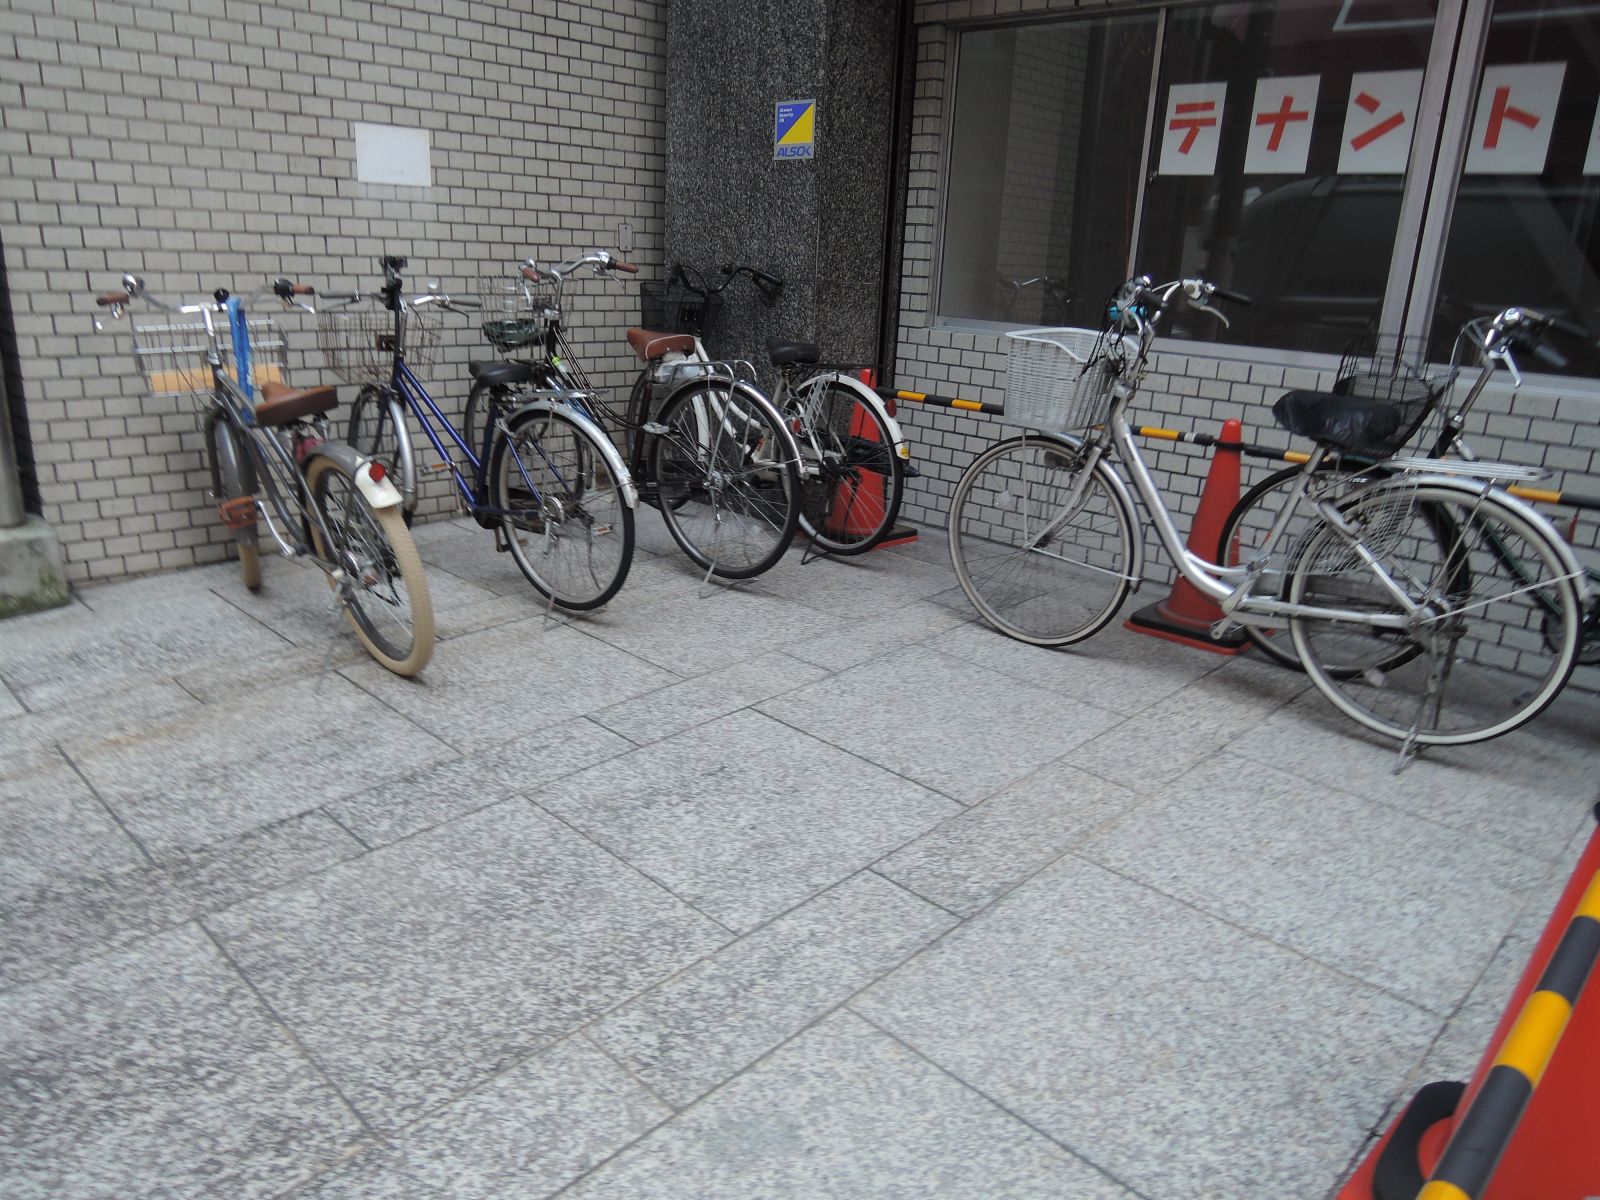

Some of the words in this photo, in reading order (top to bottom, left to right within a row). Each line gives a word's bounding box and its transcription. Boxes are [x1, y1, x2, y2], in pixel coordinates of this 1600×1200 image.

[1169, 86, 1540, 153] テナント
[777, 146, 812, 157] ALSOK
